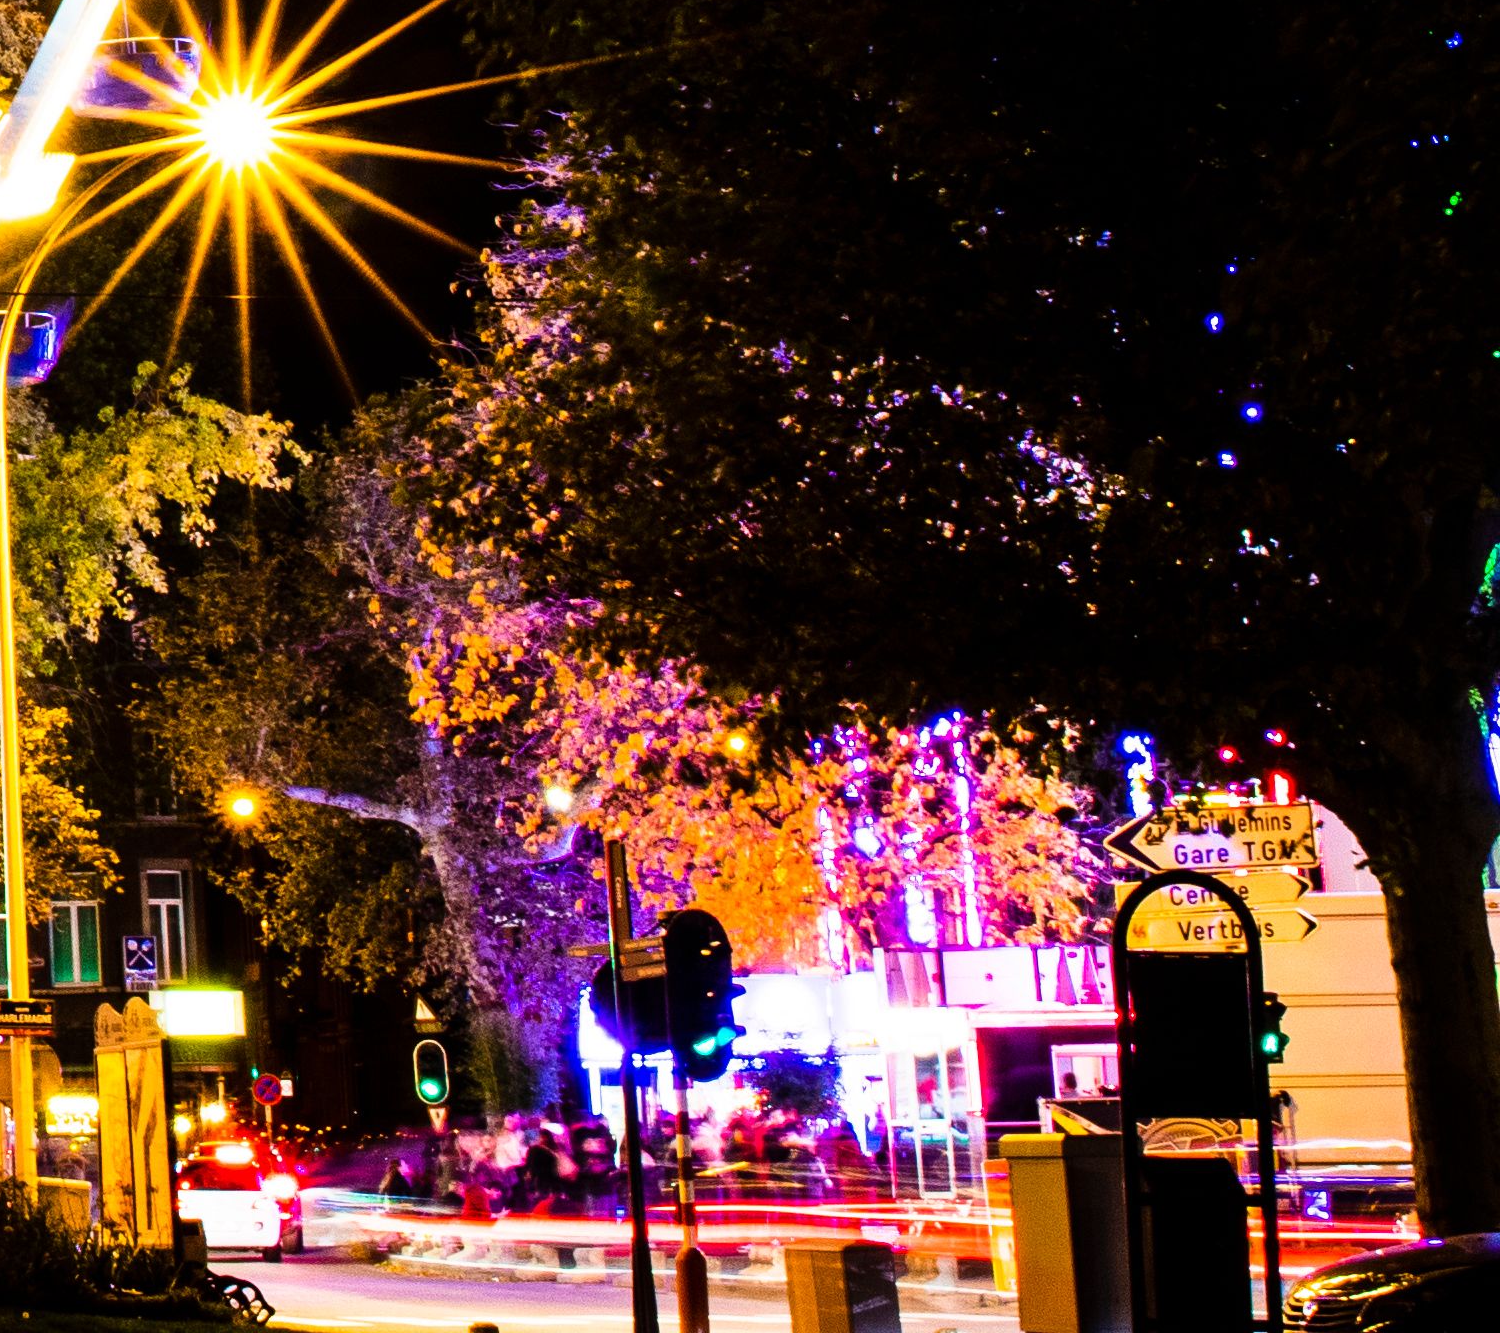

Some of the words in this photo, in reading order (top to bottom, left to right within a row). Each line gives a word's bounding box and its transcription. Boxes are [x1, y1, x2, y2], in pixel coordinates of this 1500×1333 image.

[1198, 813, 1291, 835] Gulemins
[1174, 844, 1230, 865] Gare
[1170, 885, 1249, 906] Cene
[1178, 918, 1275, 941] Vertbis
